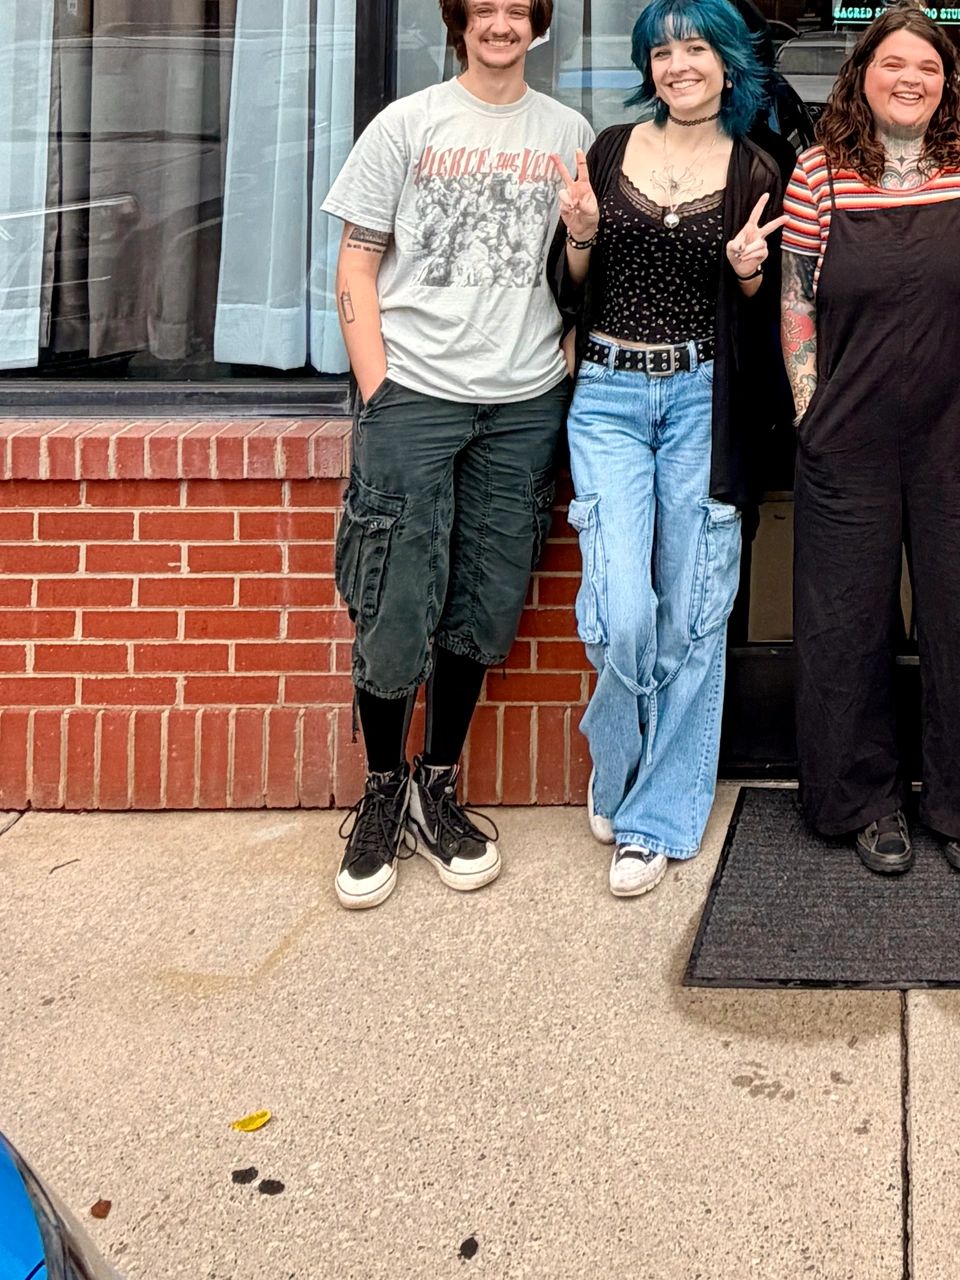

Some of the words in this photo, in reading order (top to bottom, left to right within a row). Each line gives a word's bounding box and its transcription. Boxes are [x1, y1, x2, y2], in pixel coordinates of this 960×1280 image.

[834, 7, 873, 19] SACRED
[414, 145, 492, 186] PIERCE
[493, 150, 521, 173] THE
